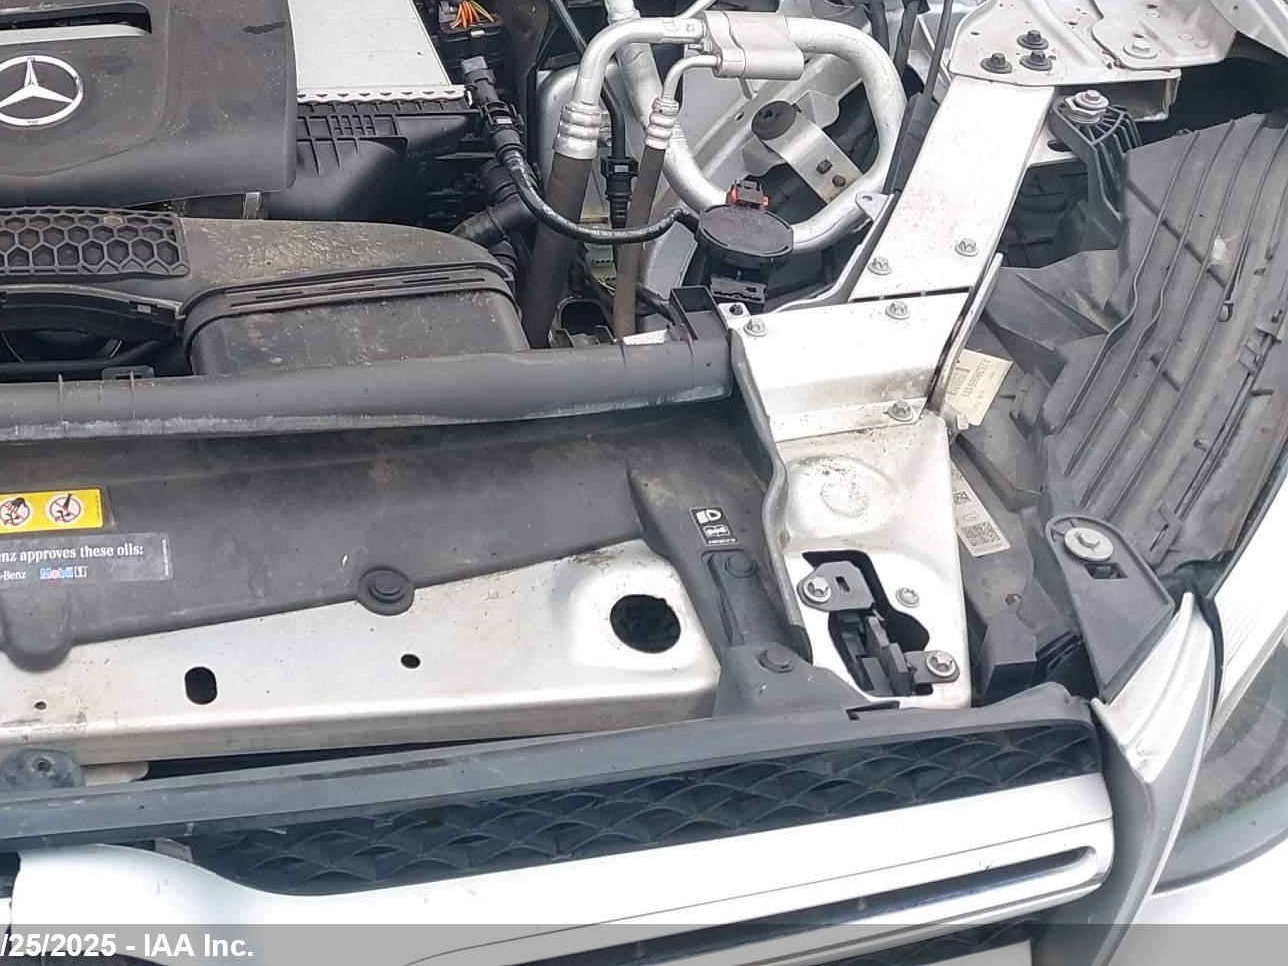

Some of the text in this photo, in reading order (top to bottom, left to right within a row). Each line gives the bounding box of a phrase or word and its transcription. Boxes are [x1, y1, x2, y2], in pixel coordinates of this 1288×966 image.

[19, 546, 77, 563] approves
[79, 545, 114, 558] these
[116, 543, 144, 556] oils:
